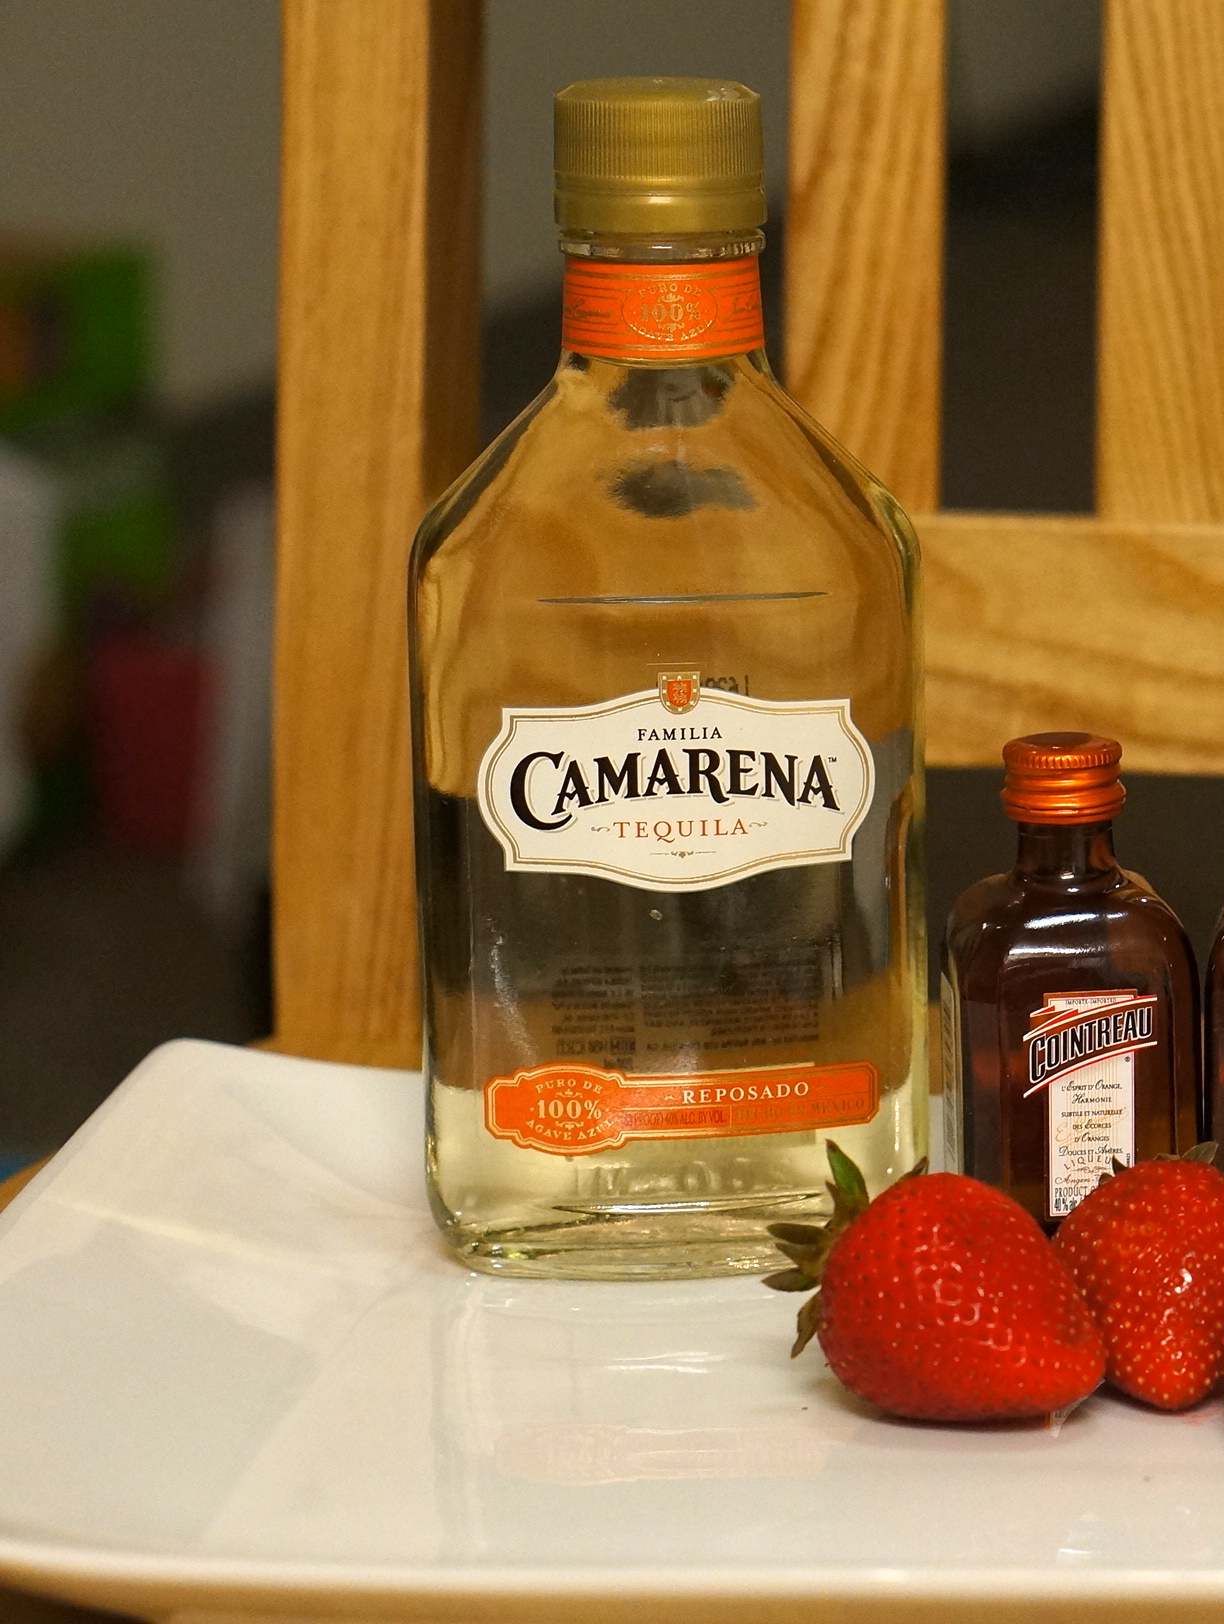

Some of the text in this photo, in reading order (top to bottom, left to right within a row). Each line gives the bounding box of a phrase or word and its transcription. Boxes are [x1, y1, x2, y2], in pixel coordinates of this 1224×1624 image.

[641, 302, 701, 322] 100%
[637, 727, 724, 742] FAMILIA
[613, 818, 749, 844] TEQUILA
[1030, 1006, 1153, 1084] COINTREAU
[536, 1078, 603, 1094] PURO DE
[682, 1082, 810, 1105] REPOSADO
[537, 1099, 602, 1119] 100%
[812, 1098, 865, 1114] MEXICO
[1062, 1110, 1083, 1118] SUBTILE
[698, 1111, 708, 1124] BY
[526, 1120, 616, 1141] AGAVE AZUL
[1064, 1155, 1112, 1170] LIQUEU
[1054, 1174, 1090, 1186] Angers
[1054, 1186, 1088, 1198] PRODUCT
